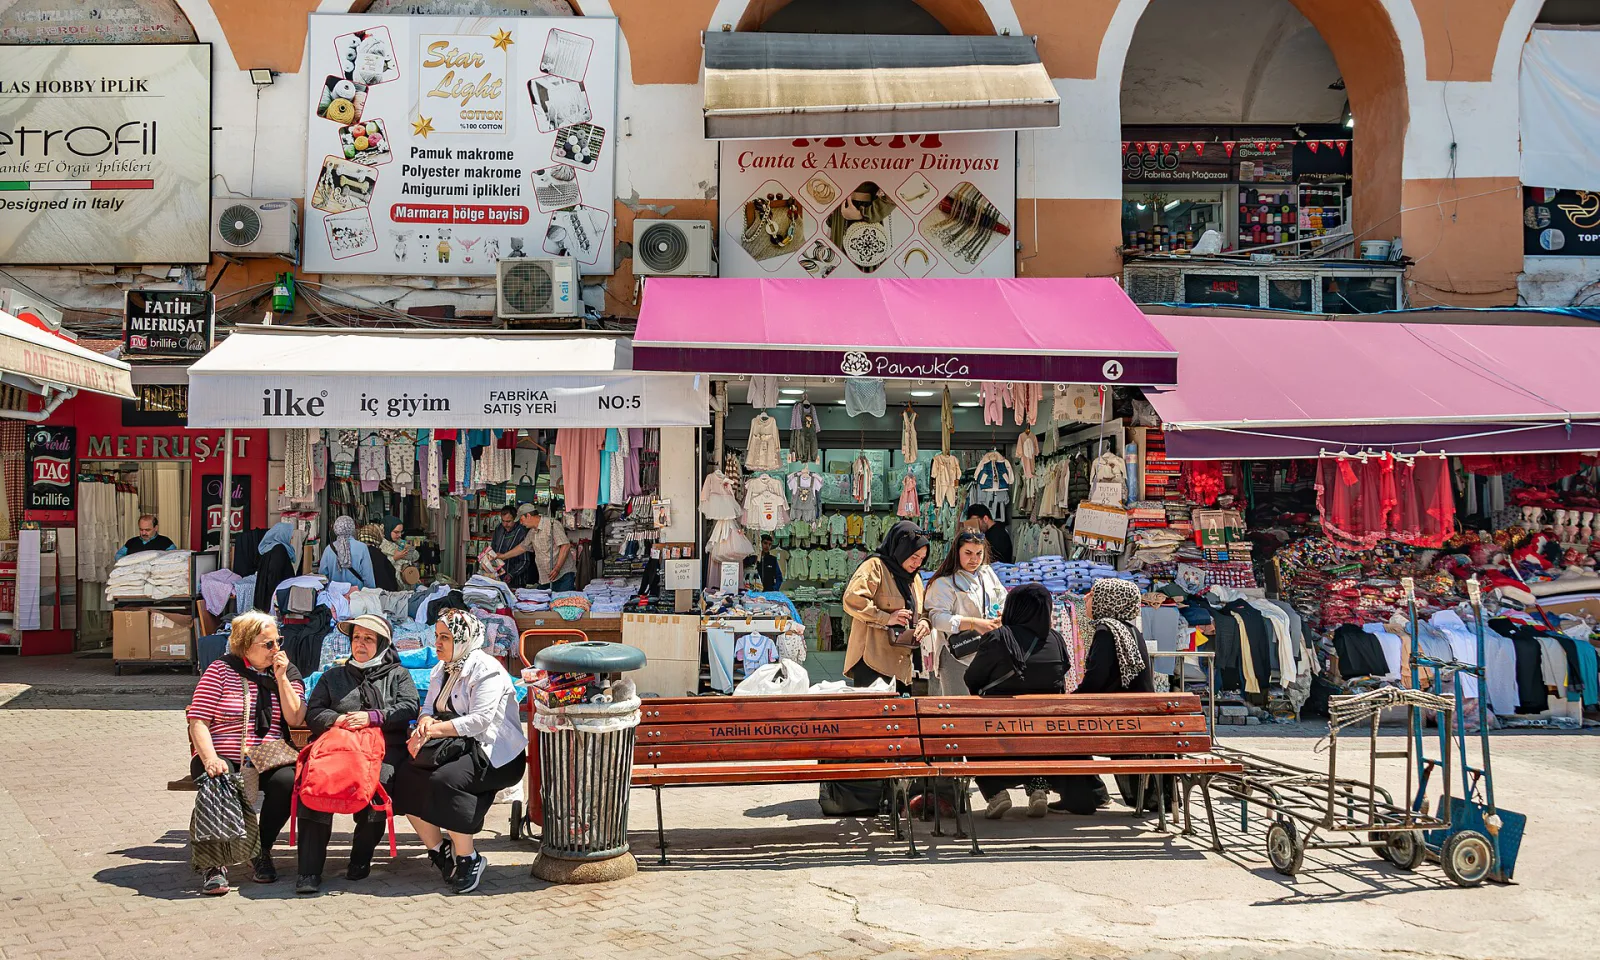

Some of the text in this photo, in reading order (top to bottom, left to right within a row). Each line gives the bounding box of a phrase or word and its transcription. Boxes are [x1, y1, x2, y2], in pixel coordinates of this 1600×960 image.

[423, 40, 486, 69] Star
[36, 79, 96, 93] HOBBY
[100, 77, 149, 93] İPLİK
[426, 71, 504, 108] Light
[459, 110, 503, 121] COTTON
[410, 146, 514, 161] Pamuk makrome
[34, 159, 52, 173] El
[56, 159, 91, 178] Örgü
[95, 158, 152, 175] İplikleri
[737, 150, 1000, 175] Çanta & Aksesuar Dünyası
[402, 163, 522, 182] Polyester makrome
[1144, 170, 1228, 180] Fabrika Satış Mağazası
[402, 183, 521, 199] Amigurumi iplikleri
[0, 197, 125, 214] Designed in Italy
[395, 206, 523, 223] Marmara bölge bayisi
[145, 297, 191, 315] FATİH
[131, 317, 205, 335] MEFRUŞAT
[150, 338, 177, 348] brillife
[178, 337, 203, 351] Verdi
[876, 355, 970, 379] PamukÇa
[1107, 363, 1119, 377] 4
[262, 388, 450, 418] ilke iç giyim
[489, 388, 550, 402] FABRİKA
[598, 395, 642, 410] NO:5
[483, 400, 558, 416] SATIŞ YERİ
[33, 430, 70, 451] Verdi
[87, 436, 250, 463] MEFRUŞAT
[207, 480, 244, 499] Vdi
[32, 492, 70, 506] brillife
[709, 722, 840, 739] TARİHİ KÜRKÇÜ HAN
[985, 716, 1143, 733] FATİH BELEDİYESİ
